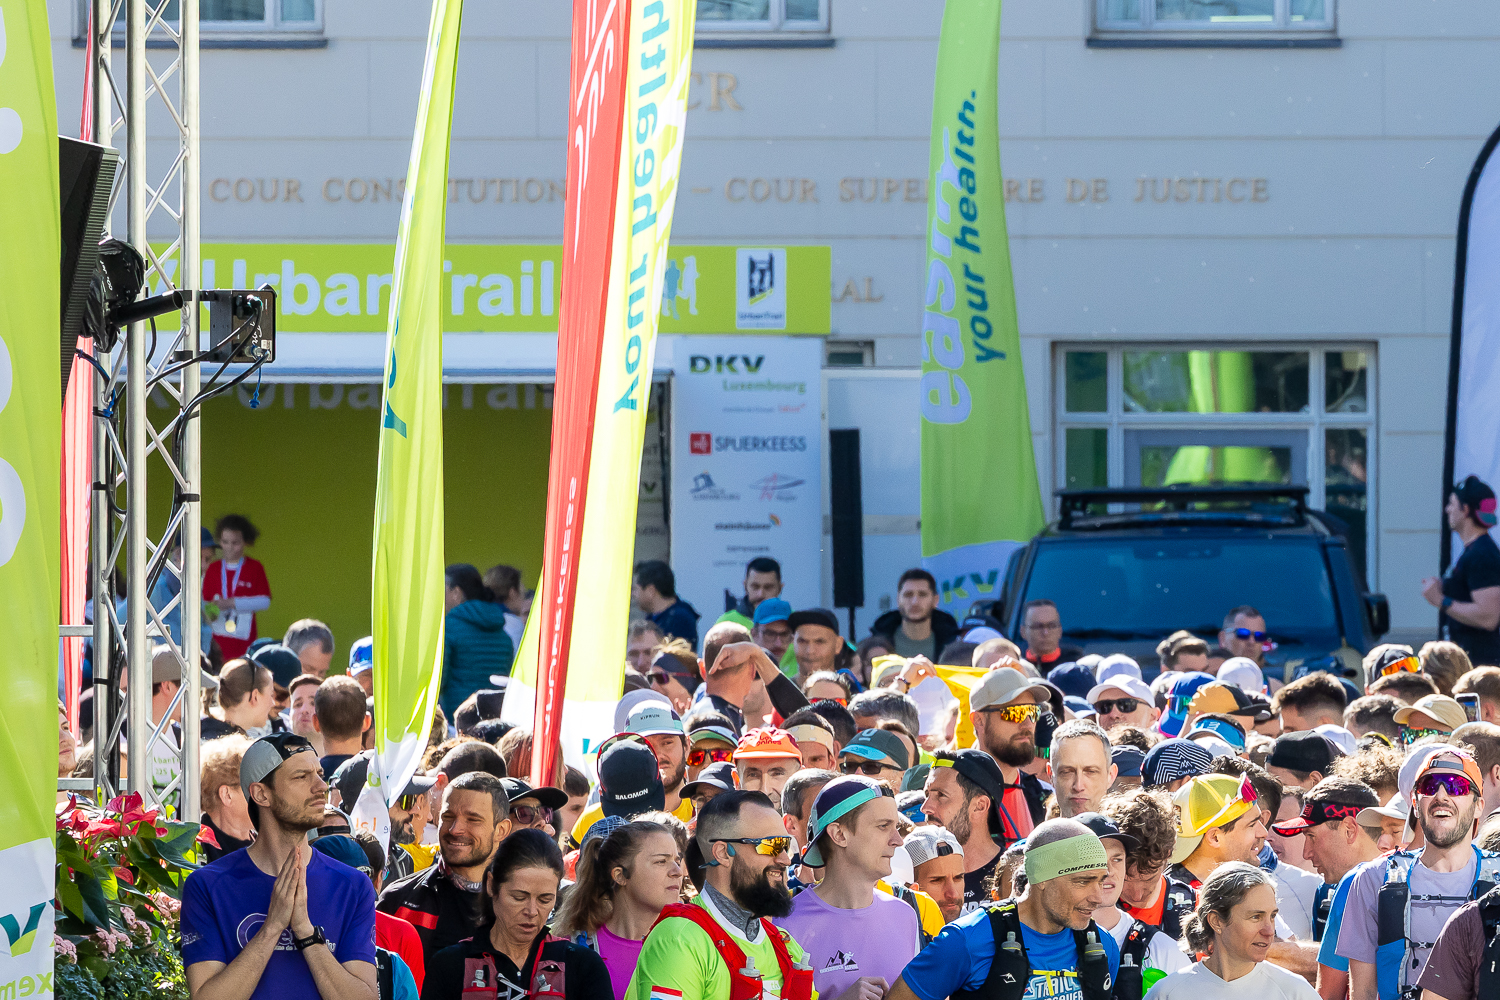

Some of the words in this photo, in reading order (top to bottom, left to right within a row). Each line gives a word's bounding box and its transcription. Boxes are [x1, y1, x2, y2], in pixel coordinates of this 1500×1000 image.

[953, 89, 982, 252] health.
[208, 177, 304, 203] COUR
[724, 177, 819, 203] COUR
[1065, 177, 1109, 203] DE
[1132, 177, 1269, 203] JUSTICE
[963, 262, 1007, 364] your
[689, 354, 765, 374] DKV
[722, 379, 807, 395] Luxembourg
[714, 435, 807, 452] SPUERKEESS
[941, 568, 1000, 605] KV
[640, 713, 661, 721] KIPRUN
[614, 787, 649, 801] SALOMON
